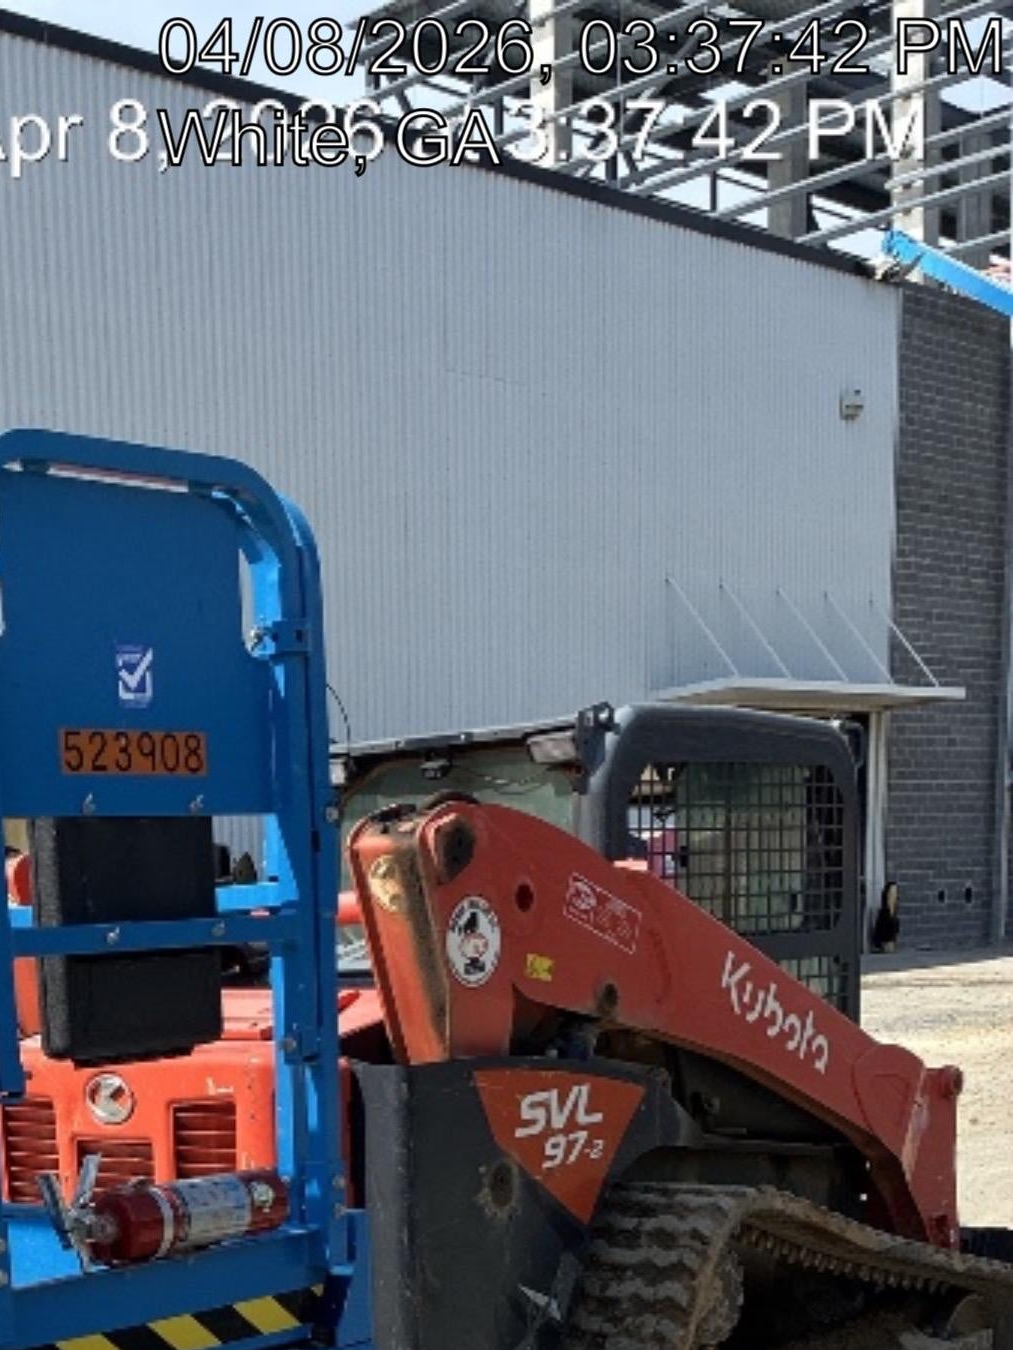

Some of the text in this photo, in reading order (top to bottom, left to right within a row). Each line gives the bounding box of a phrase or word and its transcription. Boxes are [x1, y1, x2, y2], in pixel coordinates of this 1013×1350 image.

[64, 731, 204, 775] 523908
[721, 950, 829, 1075] Kubota
[514, 1083, 604, 1138] SVL
[541, 1130, 605, 1169] 97-2
